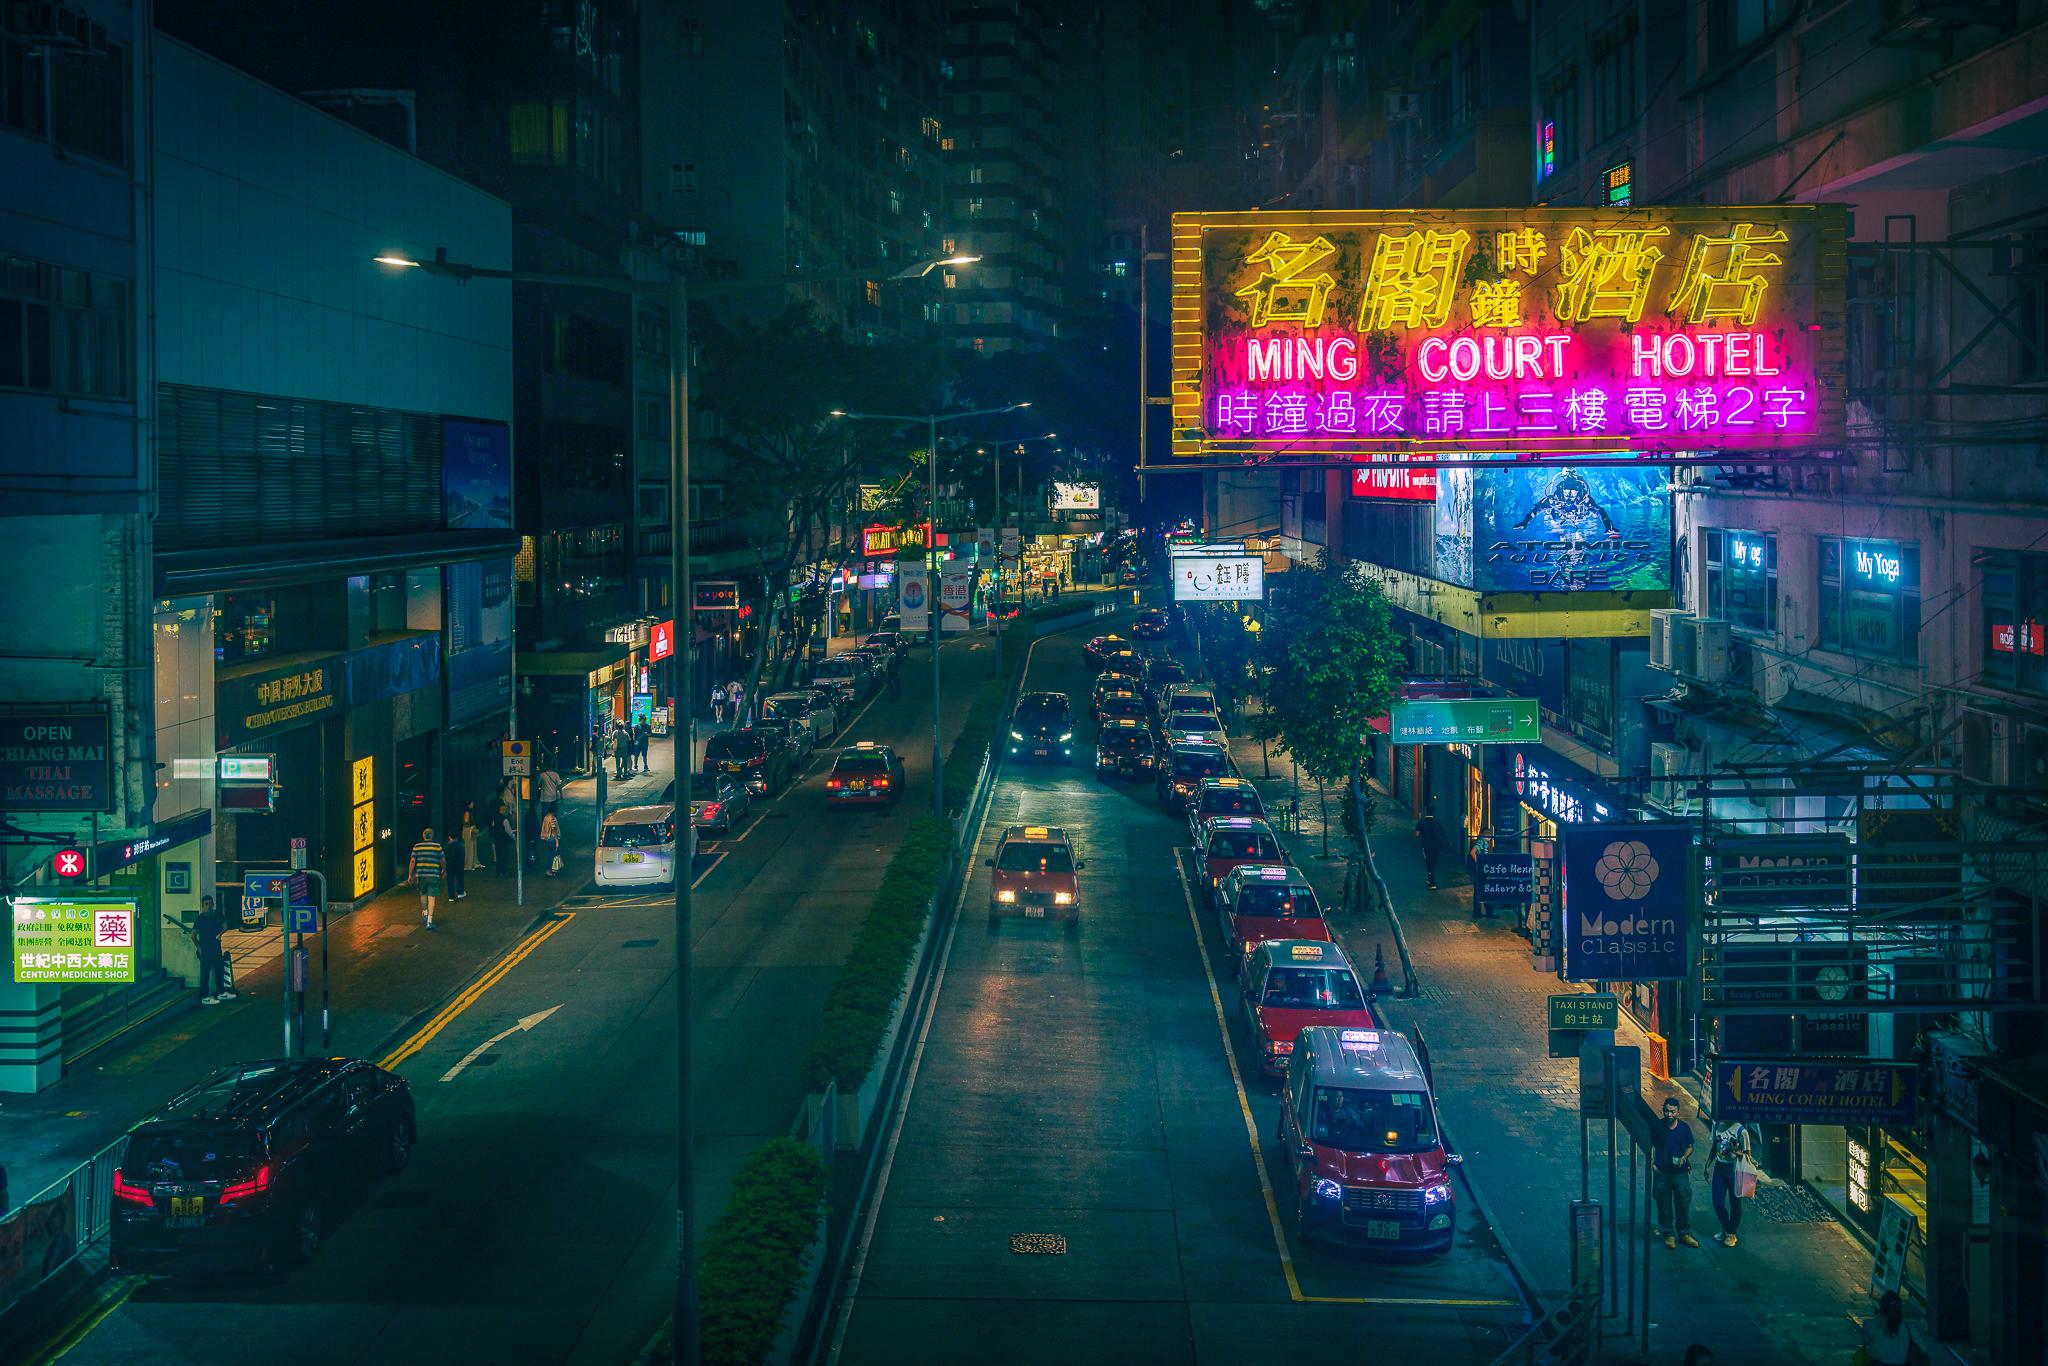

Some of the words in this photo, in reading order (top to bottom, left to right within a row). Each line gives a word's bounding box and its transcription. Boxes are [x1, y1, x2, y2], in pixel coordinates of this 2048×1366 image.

[1246, 334, 1357, 382] MING
[1416, 333, 1571, 382] COURT
[1631, 332, 1780, 378] HOTEL
[1489, 540, 1648, 552] ATOMIC
[1856, 552, 1874, 578] My
[1874, 552, 1900, 581] Yoga
[1529, 569, 1607, 585] BARE
[944, 584, 968, 596] 香港
[23, 726, 72, 740] OPEN
[67, 746, 105, 761] MAI
[27, 766, 72, 781] THAI
[227, 762, 239, 778] P
[6, 784, 94, 801] MASSAGE
[1483, 864, 1508, 875] Cafe
[1484, 885, 1516, 897] Bakery
[299, 912, 312, 930] P
[1581, 911, 1675, 936] Modern
[99, 914, 127, 944] 藥
[1581, 938, 1675, 955] Classic
[20, 953, 129, 969] 世紀中西大藥店
[20, 971, 60, 980] CENTURY
[62, 971, 102, 980] MEDICINE
[105, 971, 129, 980] SHOP
[1555, 1001, 1576, 1009] TAXI
[1579, 1001, 1613, 1010] STAND
[1564, 1014, 1603, 1025] 的士站
[1806, 1021, 1860, 1031] Classic
[1746, 1093, 1784, 1104] MING
[1787, 1094, 1835, 1106] COURT
[1839, 1095, 1888, 1107] HOTEL
[1370, 1229, 1398, 1239] 3780
